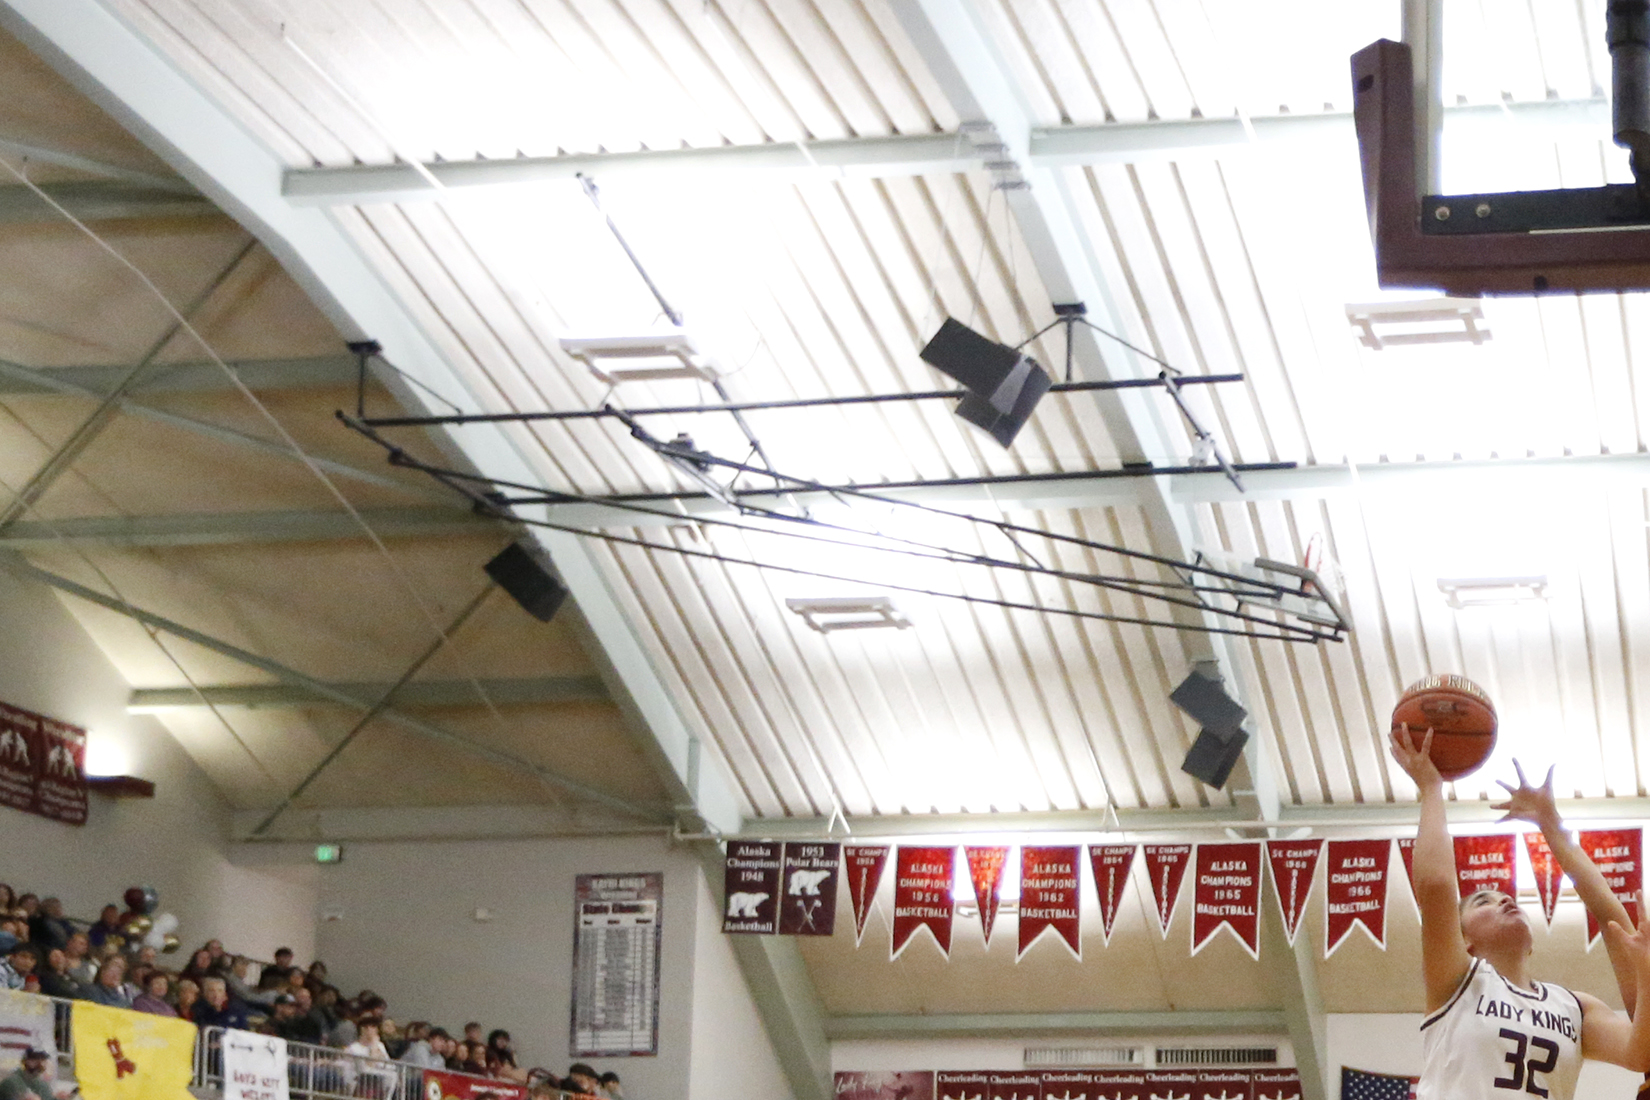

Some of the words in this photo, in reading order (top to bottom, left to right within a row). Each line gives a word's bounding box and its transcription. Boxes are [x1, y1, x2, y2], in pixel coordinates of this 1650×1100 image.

[737, 846, 771, 857] Alaska
[1104, 846, 1133, 855] CHAMPS
[1157, 846, 1188, 854] CHAMPS
[1286, 848, 1318, 858] CHAMPS
[1594, 846, 1629, 858] ALASKA
[727, 858, 780, 870] Champions
[786, 858, 808, 868] Polar
[810, 858, 839, 868] Bears
[1342, 857, 1376, 868] ALASKA
[1468, 852, 1505, 865] ALASKA
[910, 864, 943, 875] ALASKA
[1032, 863, 1072, 873] ALASKA
[1210, 861, 1247, 872] ALASKA
[1332, 871, 1382, 883] CHAMPIONS
[1460, 868, 1512, 881] CHAMPIONS
[900, 878, 951, 889] CHAMPIONS
[1022, 878, 1077, 889] CHAMPIONS
[1200, 875, 1252, 887] CHAMPIONS
[1214, 889, 1242, 900] 1965
[1197, 904, 1255, 916] BASKETBALL
[1329, 899, 1381, 914] BASKETBALL
[896, 907, 948, 918] BASKETBALL
[1021, 908, 1078, 918] BASKETBALL
[724, 922, 772, 933] Basketball
[1475, 995, 1524, 1025] LADY
[1531, 1006, 1579, 1043] KINGS
[1494, 1028, 1560, 1098] 32
[938, 1074, 988, 1083] Cheerleading
[990, 1075, 1040, 1085] Cheerleading
[1042, 1073, 1093, 1083] Cheerleading
[1094, 1074, 1145, 1085] Cheerleading
[1146, 1073, 1197, 1084] Cheerleading
[1199, 1073, 1250, 1084] Cheerleading
